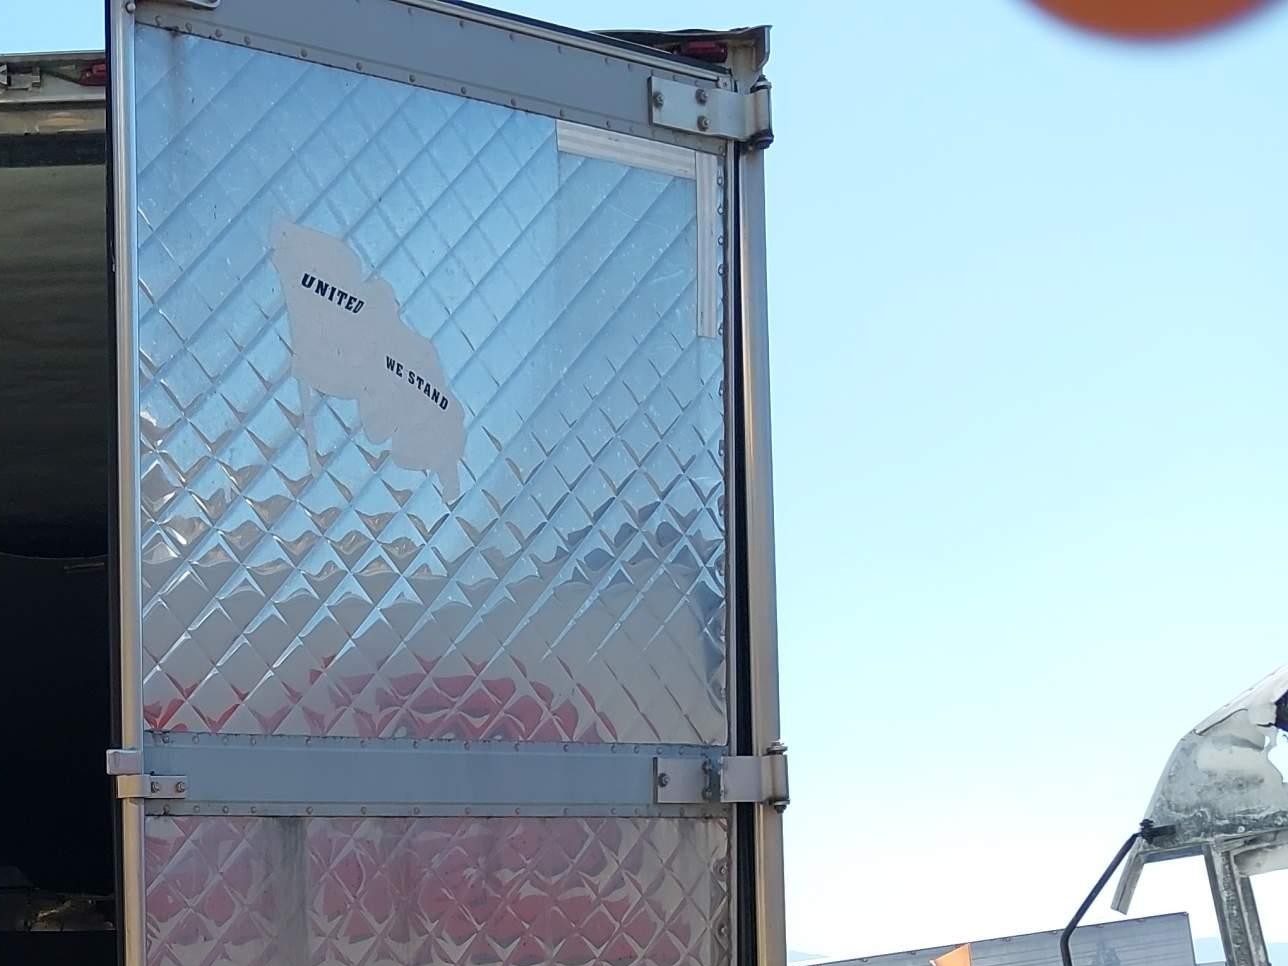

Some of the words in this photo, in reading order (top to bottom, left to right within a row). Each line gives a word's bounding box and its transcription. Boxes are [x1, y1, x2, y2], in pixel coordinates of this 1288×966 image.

[301, 272, 365, 314] UNITED
[385, 356, 403, 377] WE
[408, 371, 449, 411] STAND
